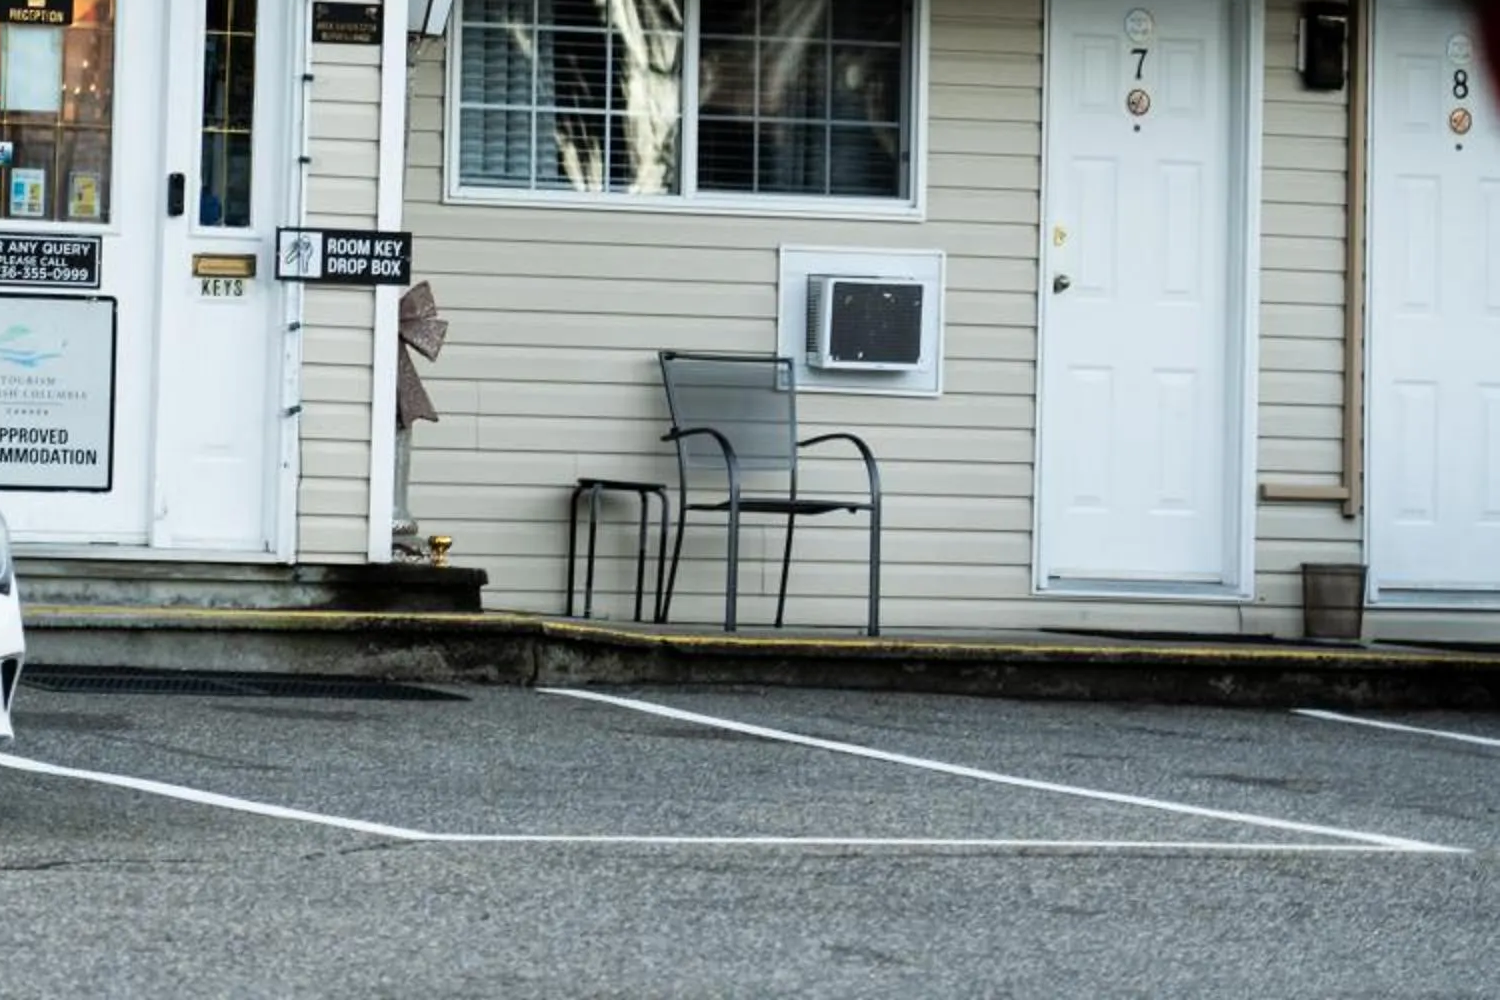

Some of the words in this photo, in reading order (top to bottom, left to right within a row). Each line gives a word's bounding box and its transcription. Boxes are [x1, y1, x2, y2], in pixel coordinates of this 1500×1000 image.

[9, 7, 65, 24] RECEPTION
[1131, 48, 1149, 80] 7
[1453, 68, 1469, 99] 8
[8, 241, 38, 254] ANY
[41, 242, 91, 257] QUERY
[327, 238, 370, 256] ROOM
[373, 240, 403, 257] KEY
[40, 257, 68, 267] CALL
[327, 257, 367, 274] DROP
[371, 259, 401, 276] BOX
[201, 279, 243, 297] KEYS
[0, 375, 56, 386] TOURISM
